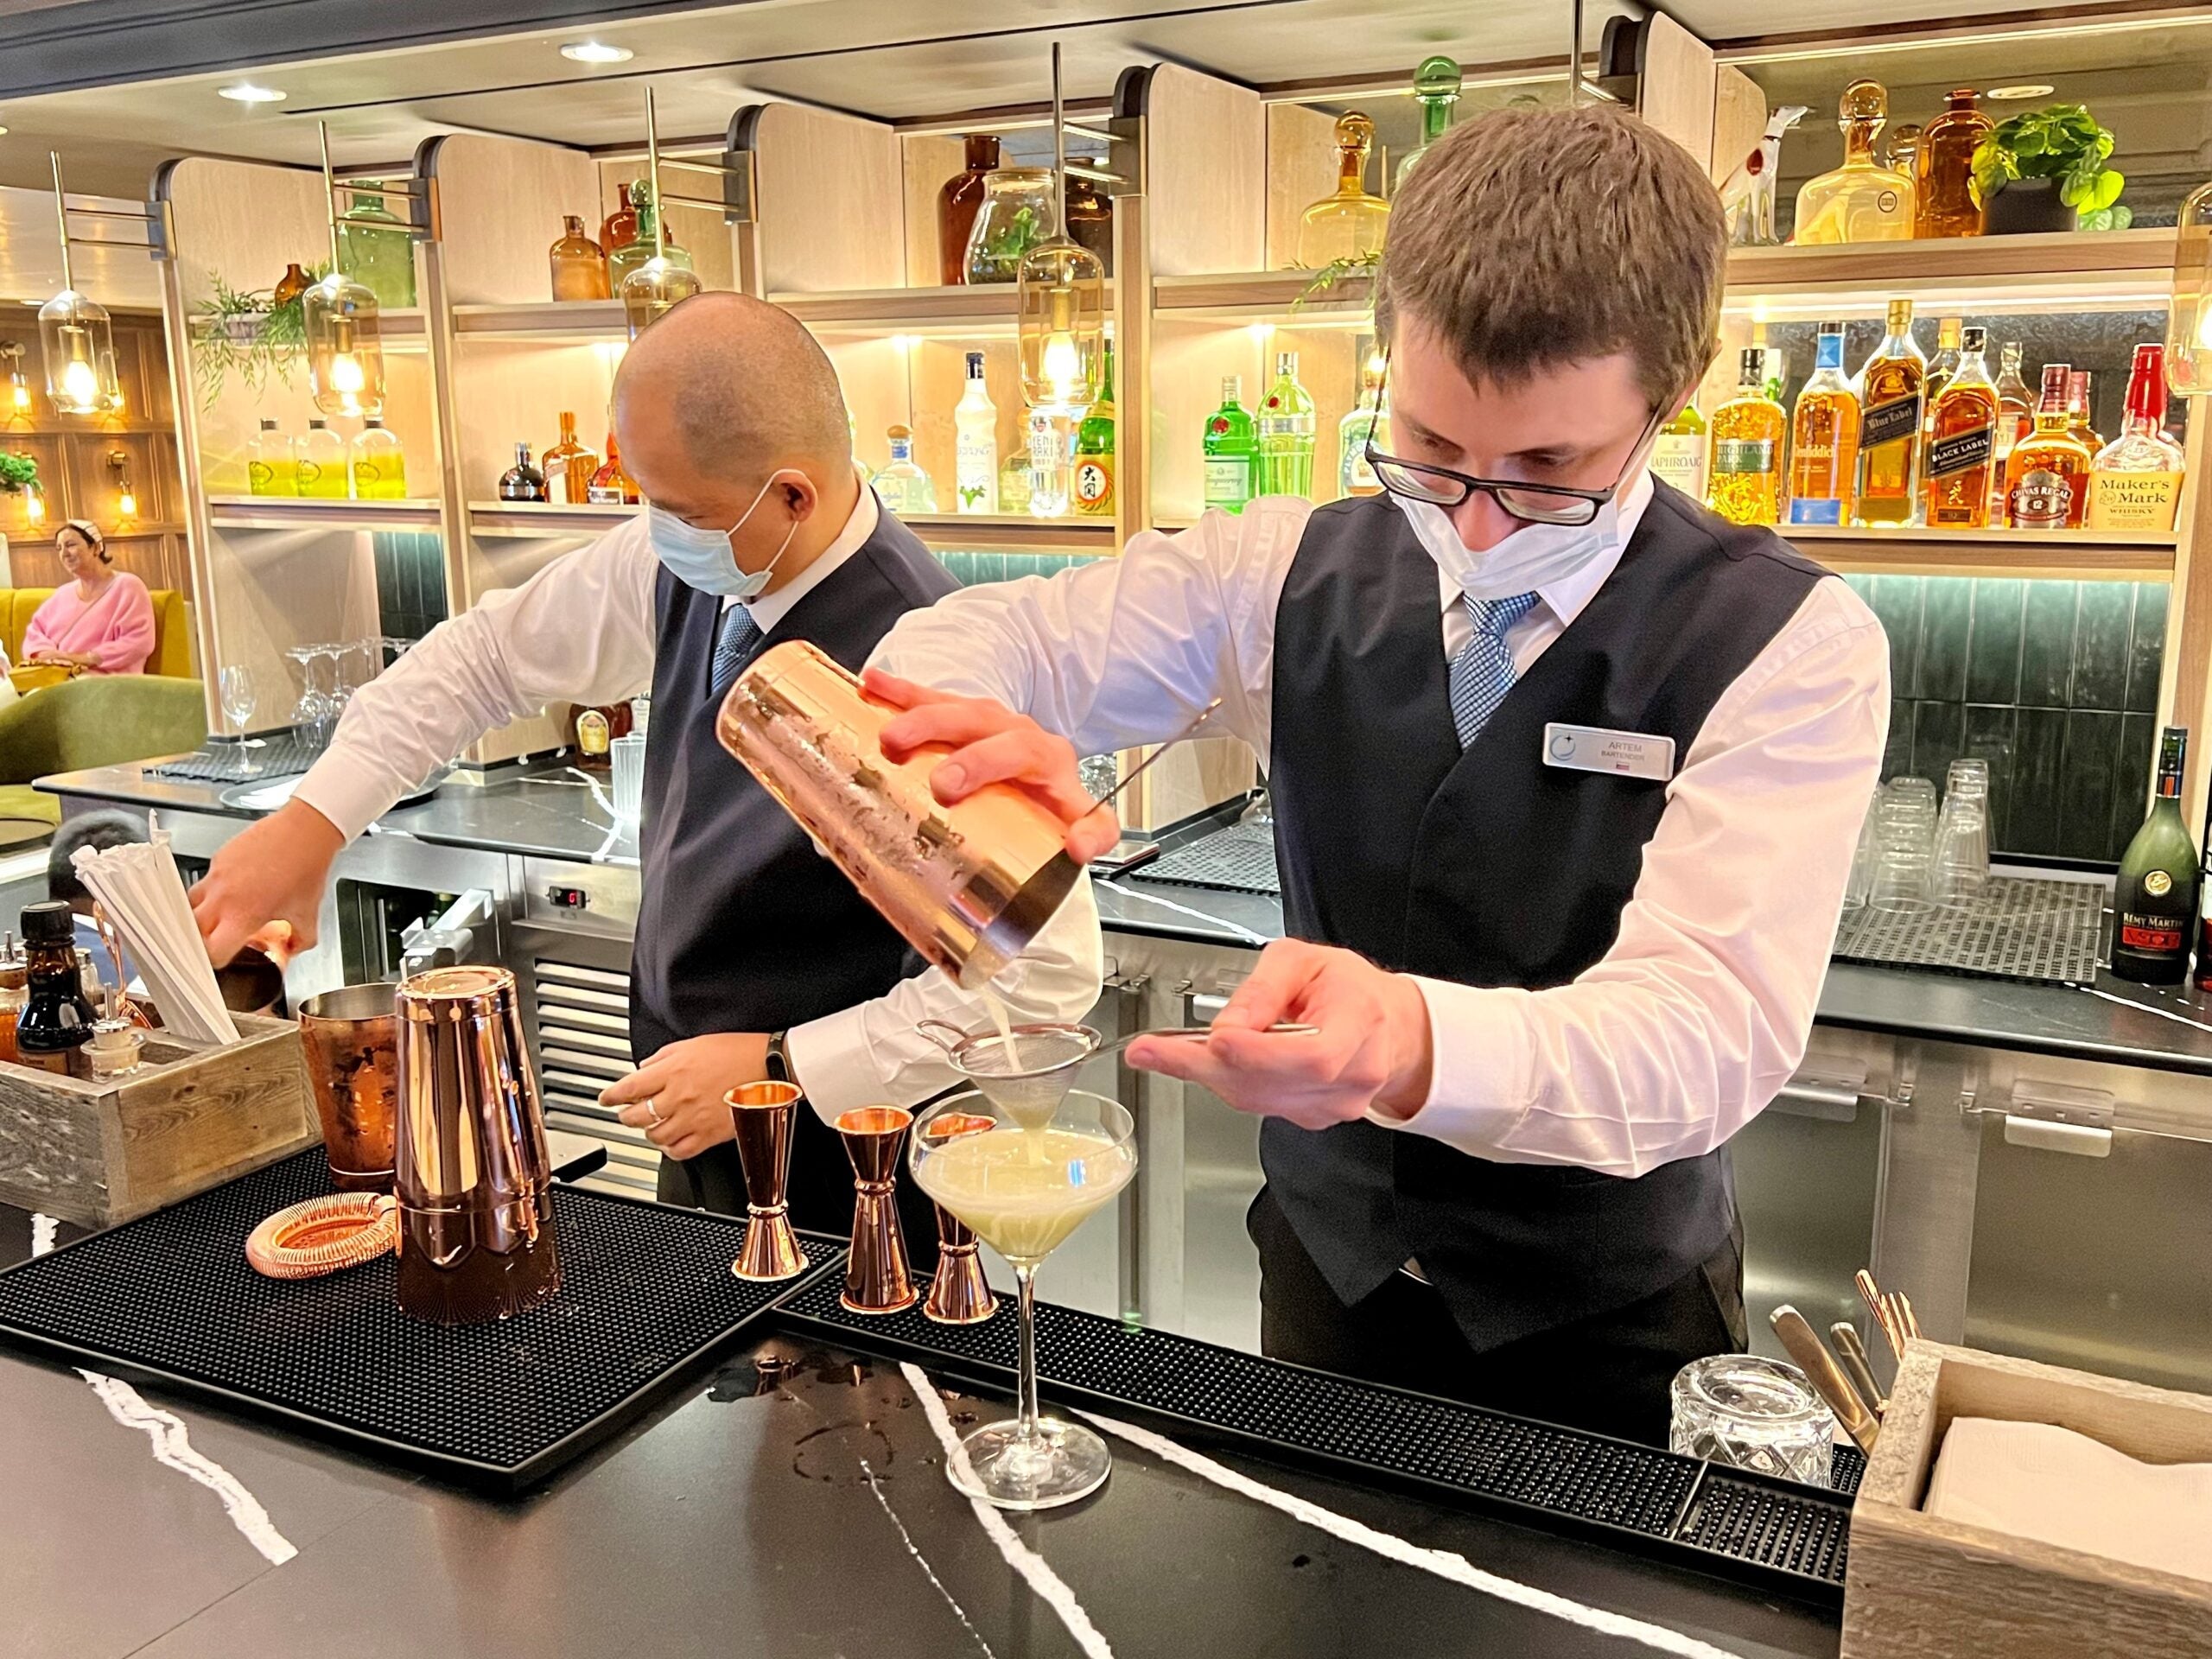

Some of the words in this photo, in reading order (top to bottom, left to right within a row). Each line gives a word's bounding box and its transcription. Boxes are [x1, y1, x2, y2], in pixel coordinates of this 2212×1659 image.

[1867, 416, 1889, 429] Blue
[1889, 406, 1912, 423] Label
[1716, 443, 1773, 455] HIGHLAND
[1932, 448, 1959, 462] BLACK
[1961, 439, 1989, 453] LABEL
[1650, 455, 1702, 467] LAPHROAIG
[2099, 479, 2171, 490] Maker's
[2011, 486, 2040, 500] CHIVAS
[2040, 486, 2069, 499] REGAL
[2118, 492, 2167, 504] Mark
[2032, 499, 2044, 510] 12
[1608, 741, 1643, 753] ARTEM
[1601, 749, 1645, 761] BARTENDER
[2147, 917, 2184, 929] MARTIN
